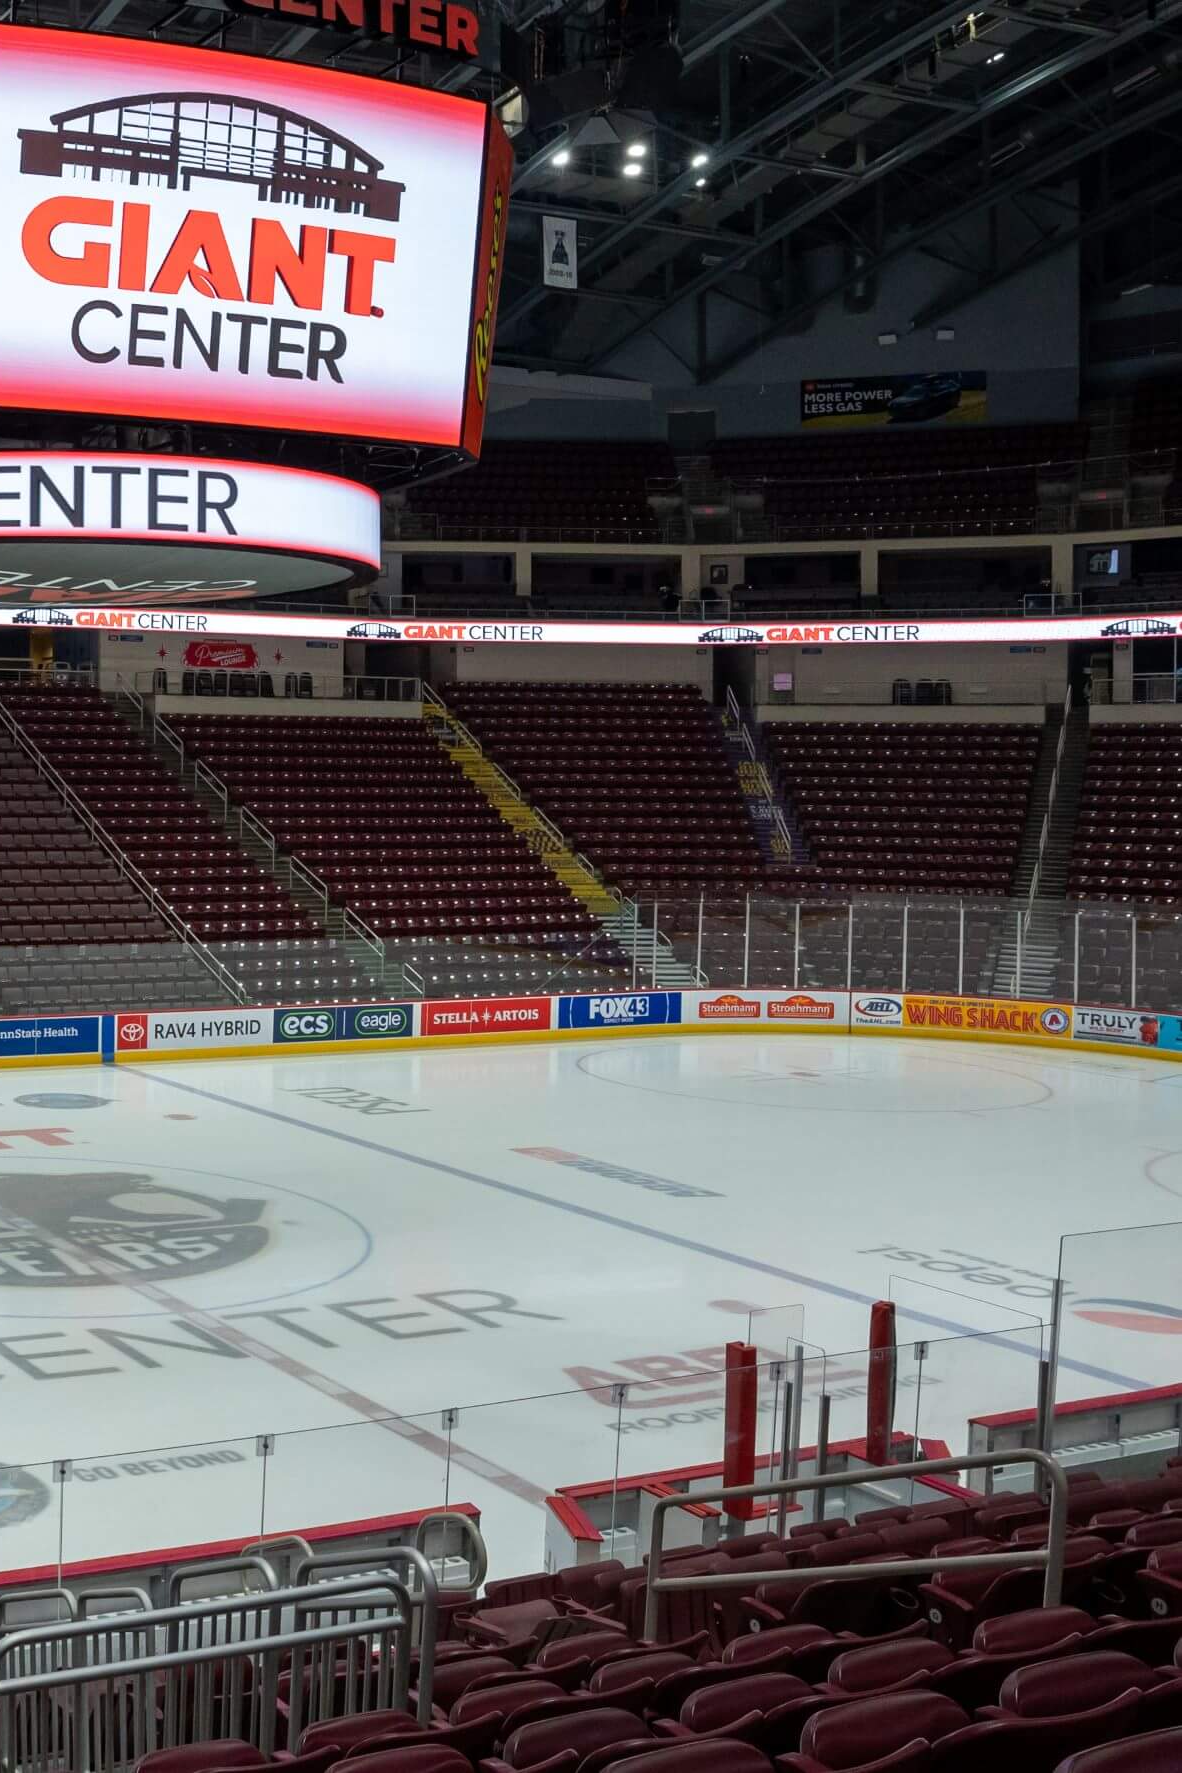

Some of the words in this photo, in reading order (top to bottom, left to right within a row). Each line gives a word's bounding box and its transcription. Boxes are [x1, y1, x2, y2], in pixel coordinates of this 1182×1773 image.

[21, 195, 396, 317] GIANT
[71, 300, 347, 384] CENTER
[803, 391, 843, 404] MORE
[845, 390, 893, 403] POWER
[803, 402, 834, 415] LESS
[835, 401, 863, 413] GAS
[75, 611, 136, 628] GIANT
[138, 613, 208, 631] CENTER
[404, 625, 467, 640] GIANT
[468, 624, 543, 641] CENTER
[766, 627, 835, 642] GIANT
[836, 625, 920, 642] CENTER
[702, 1003, 757, 1014] Stroehmann
[771, 1003, 830, 1014] Stroehmann
[864, 1001, 894, 1012] AHL
[283, 1014, 329, 1035] ecs
[360, 1011, 401, 1031] eagle
[433, 1011, 480, 1025] STELLA
[493, 1008, 539, 1022] ARTOIS
[907, 1004, 964, 1026] WING
[966, 1007, 1039, 1032] SHACK
[1077, 1012, 1137, 1030] TRULY
[43, 1026, 78, 1038] Health
[154, 1022, 196, 1040] RAV4
[201, 1019, 261, 1038] HYBRID
[70, 1465, 119, 1484] GO
[126, 1449, 248, 1477] BEYOND
